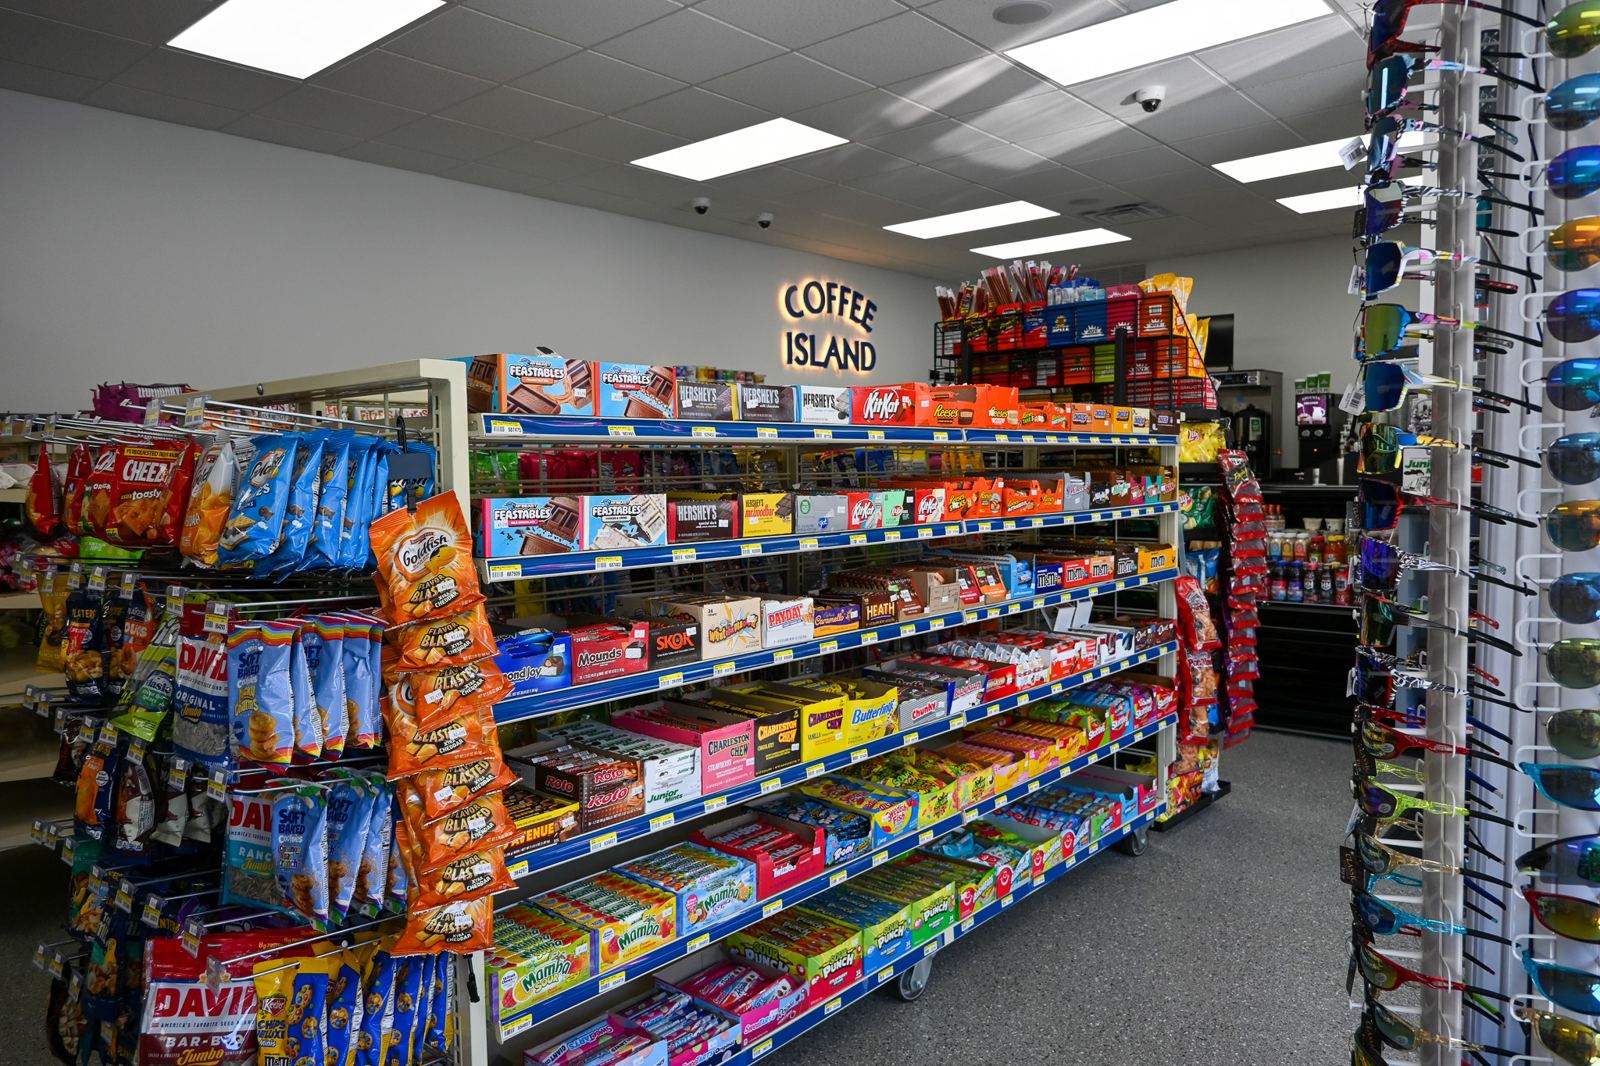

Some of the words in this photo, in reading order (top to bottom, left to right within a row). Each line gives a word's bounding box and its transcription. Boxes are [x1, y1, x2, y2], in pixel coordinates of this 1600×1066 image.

[785, 281, 877, 333] COFFEE
[786, 332, 876, 371] ISLAND
[509, 365, 564, 378] FEASTABLES
[602, 373, 650, 384] FEASTABLES
[680, 385, 717, 402] HERSHEY'S
[743, 388, 779, 404] HERSHEY'S
[803, 393, 835, 408] HERSHEY'S
[1405, 460, 1432, 469] Juni
[132, 489, 162, 500] toasty
[494, 509, 552, 520] FEASTABLES
[592, 505, 641, 516] FEASTABLES
[678, 505, 717, 521] HERSHEY'S
[403, 535, 448, 567] Goldfish
[418, 574, 446, 591] FLAVOR
[434, 591, 459, 609] CHEDDAR
[769, 604, 803, 625] PAYDAY
[866, 602, 895, 620] HEATH
[428, 622, 459, 635] FLAVOR
[656, 632, 695, 650] SKOR
[179, 642, 228, 682] DAVID
[238, 651, 263, 668] SOFT
[577, 647, 623, 667] Mounds
[237, 666, 260, 679] BAKED
[525, 665, 543, 679] Joy
[461, 678, 485, 696] CHEDDAR
[175, 690, 216, 711] ORIGINAL
[808, 708, 844, 728] CHARLESTON
[911, 701, 936, 720] Chunky
[757, 719, 798, 742] CHARLESTON
[439, 739, 465, 754] CHEDDAR
[708, 733, 750, 756] CHARLESTON
[730, 743, 749, 757] CHEW
[443, 760, 490, 786] BLASTED
[594, 768, 625, 784] Rolo
[471, 775, 495, 792] CHEDDAR
[545, 774, 574, 792] Rolo
[587, 786, 629, 809] Rolo
[647, 789, 679, 804] Junior
[664, 794, 683, 803] Mints
[278, 808, 306, 824] SOFT
[278, 823, 306, 835] BAKED
[239, 847, 272, 861] RANC
[466, 876, 492, 892] CHEDDAR
[704, 888, 739, 912] Mamba
[922, 900, 948, 921] PUNCH
[446, 933, 472, 943] CHEDDAR
[618, 923, 660, 950] Mamba
[877, 925, 905, 949] PUNCH
[752, 942, 779, 959] SOUR
[744, 948, 790, 973] PUNCH
[822, 953, 855, 979] PUNCH
[521, 959, 572, 993] Mamba
[534, 973, 560, 994] SOUR
[152, 985, 259, 1018] DAVID
[257, 1019, 286, 1030] CHIPS
[177, 1047, 225, 1065] Jumbo
